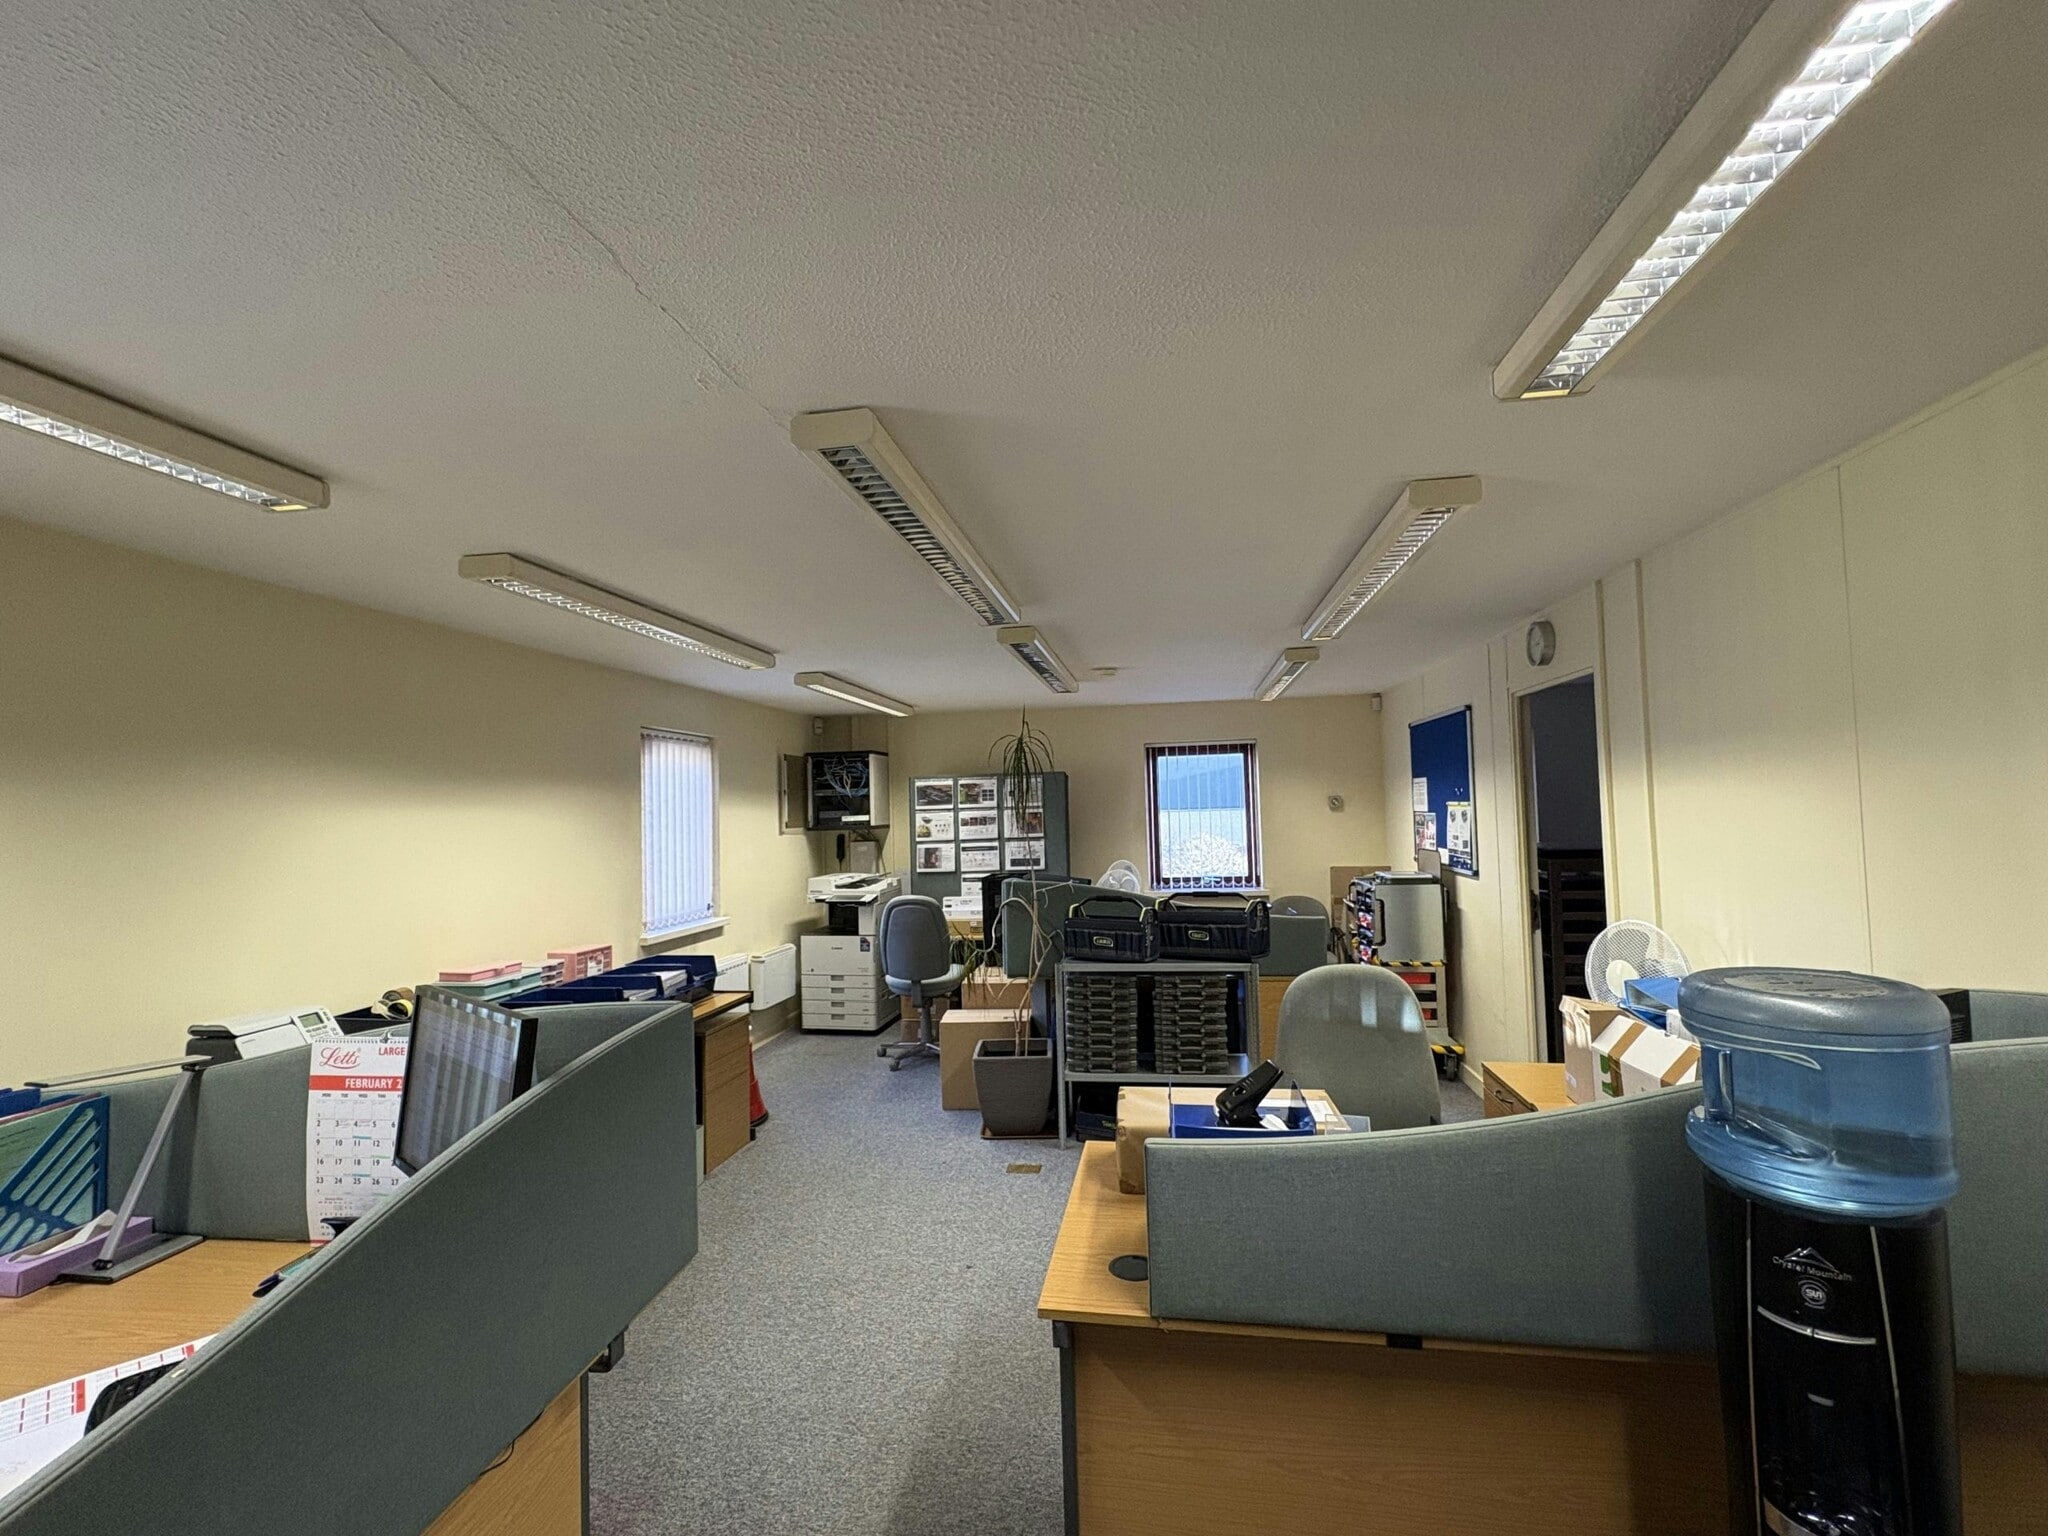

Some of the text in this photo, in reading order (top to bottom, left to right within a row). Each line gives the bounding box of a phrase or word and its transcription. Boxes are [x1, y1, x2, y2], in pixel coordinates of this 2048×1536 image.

[320, 1047, 361, 1069] Letts
[378, 1047, 406, 1056] LARGE
[345, 1078, 403, 1089] FEBRUARY 2
[1807, 1266, 1853, 1281] Mountain
